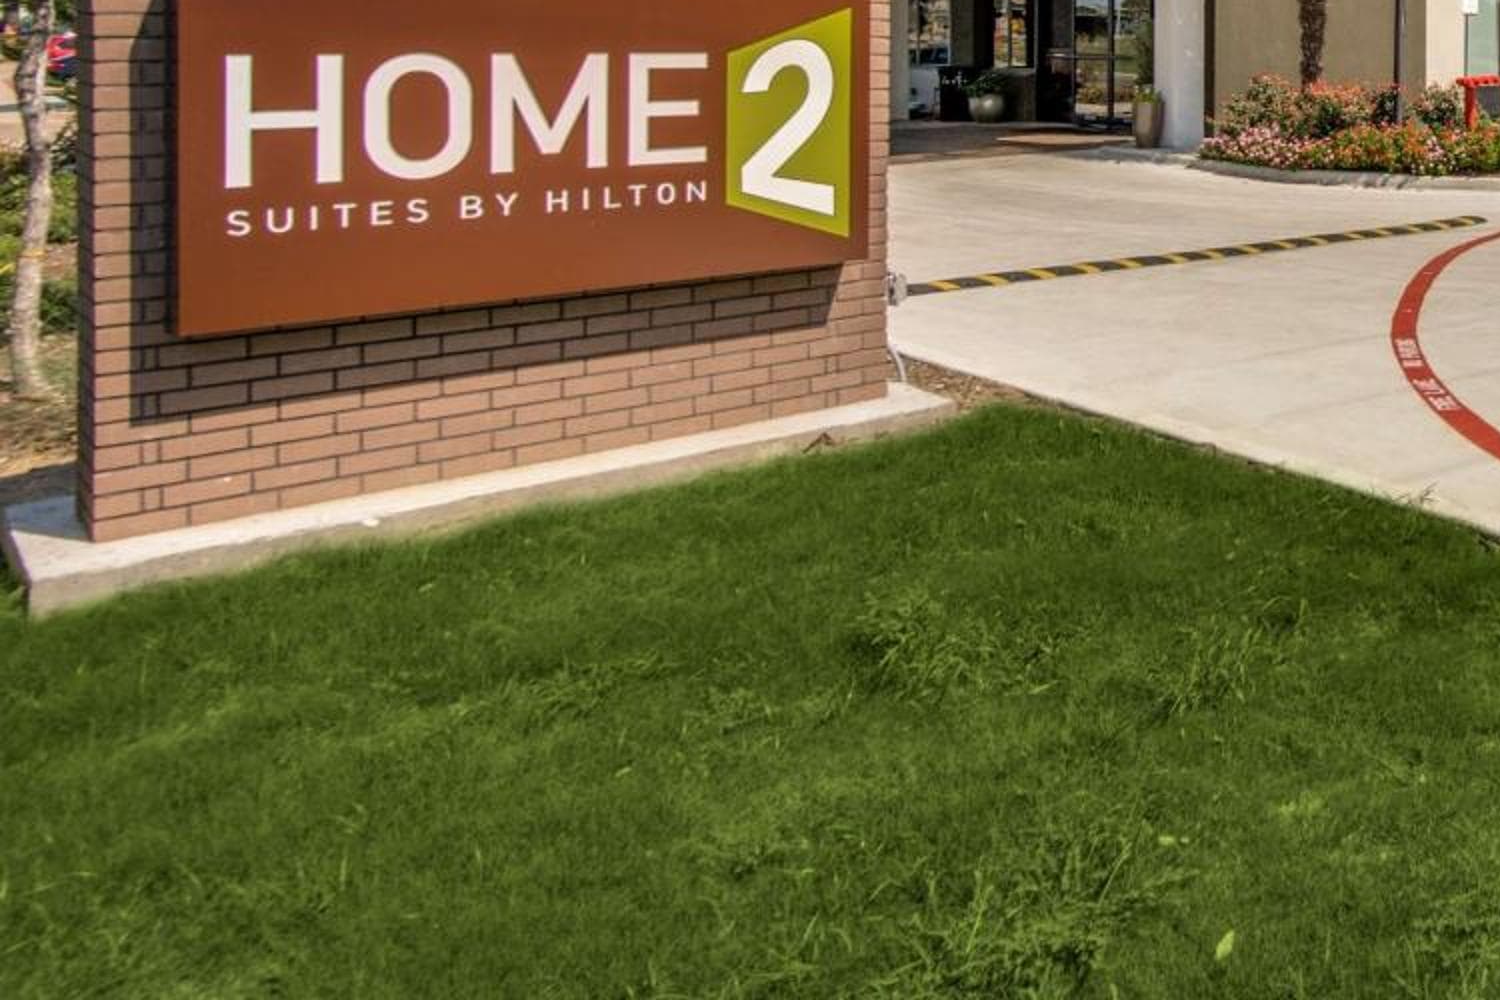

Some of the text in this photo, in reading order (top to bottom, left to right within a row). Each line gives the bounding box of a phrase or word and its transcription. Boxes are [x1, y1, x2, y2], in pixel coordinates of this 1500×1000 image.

[225, 182, 708, 236] SUITES BY HILTON
